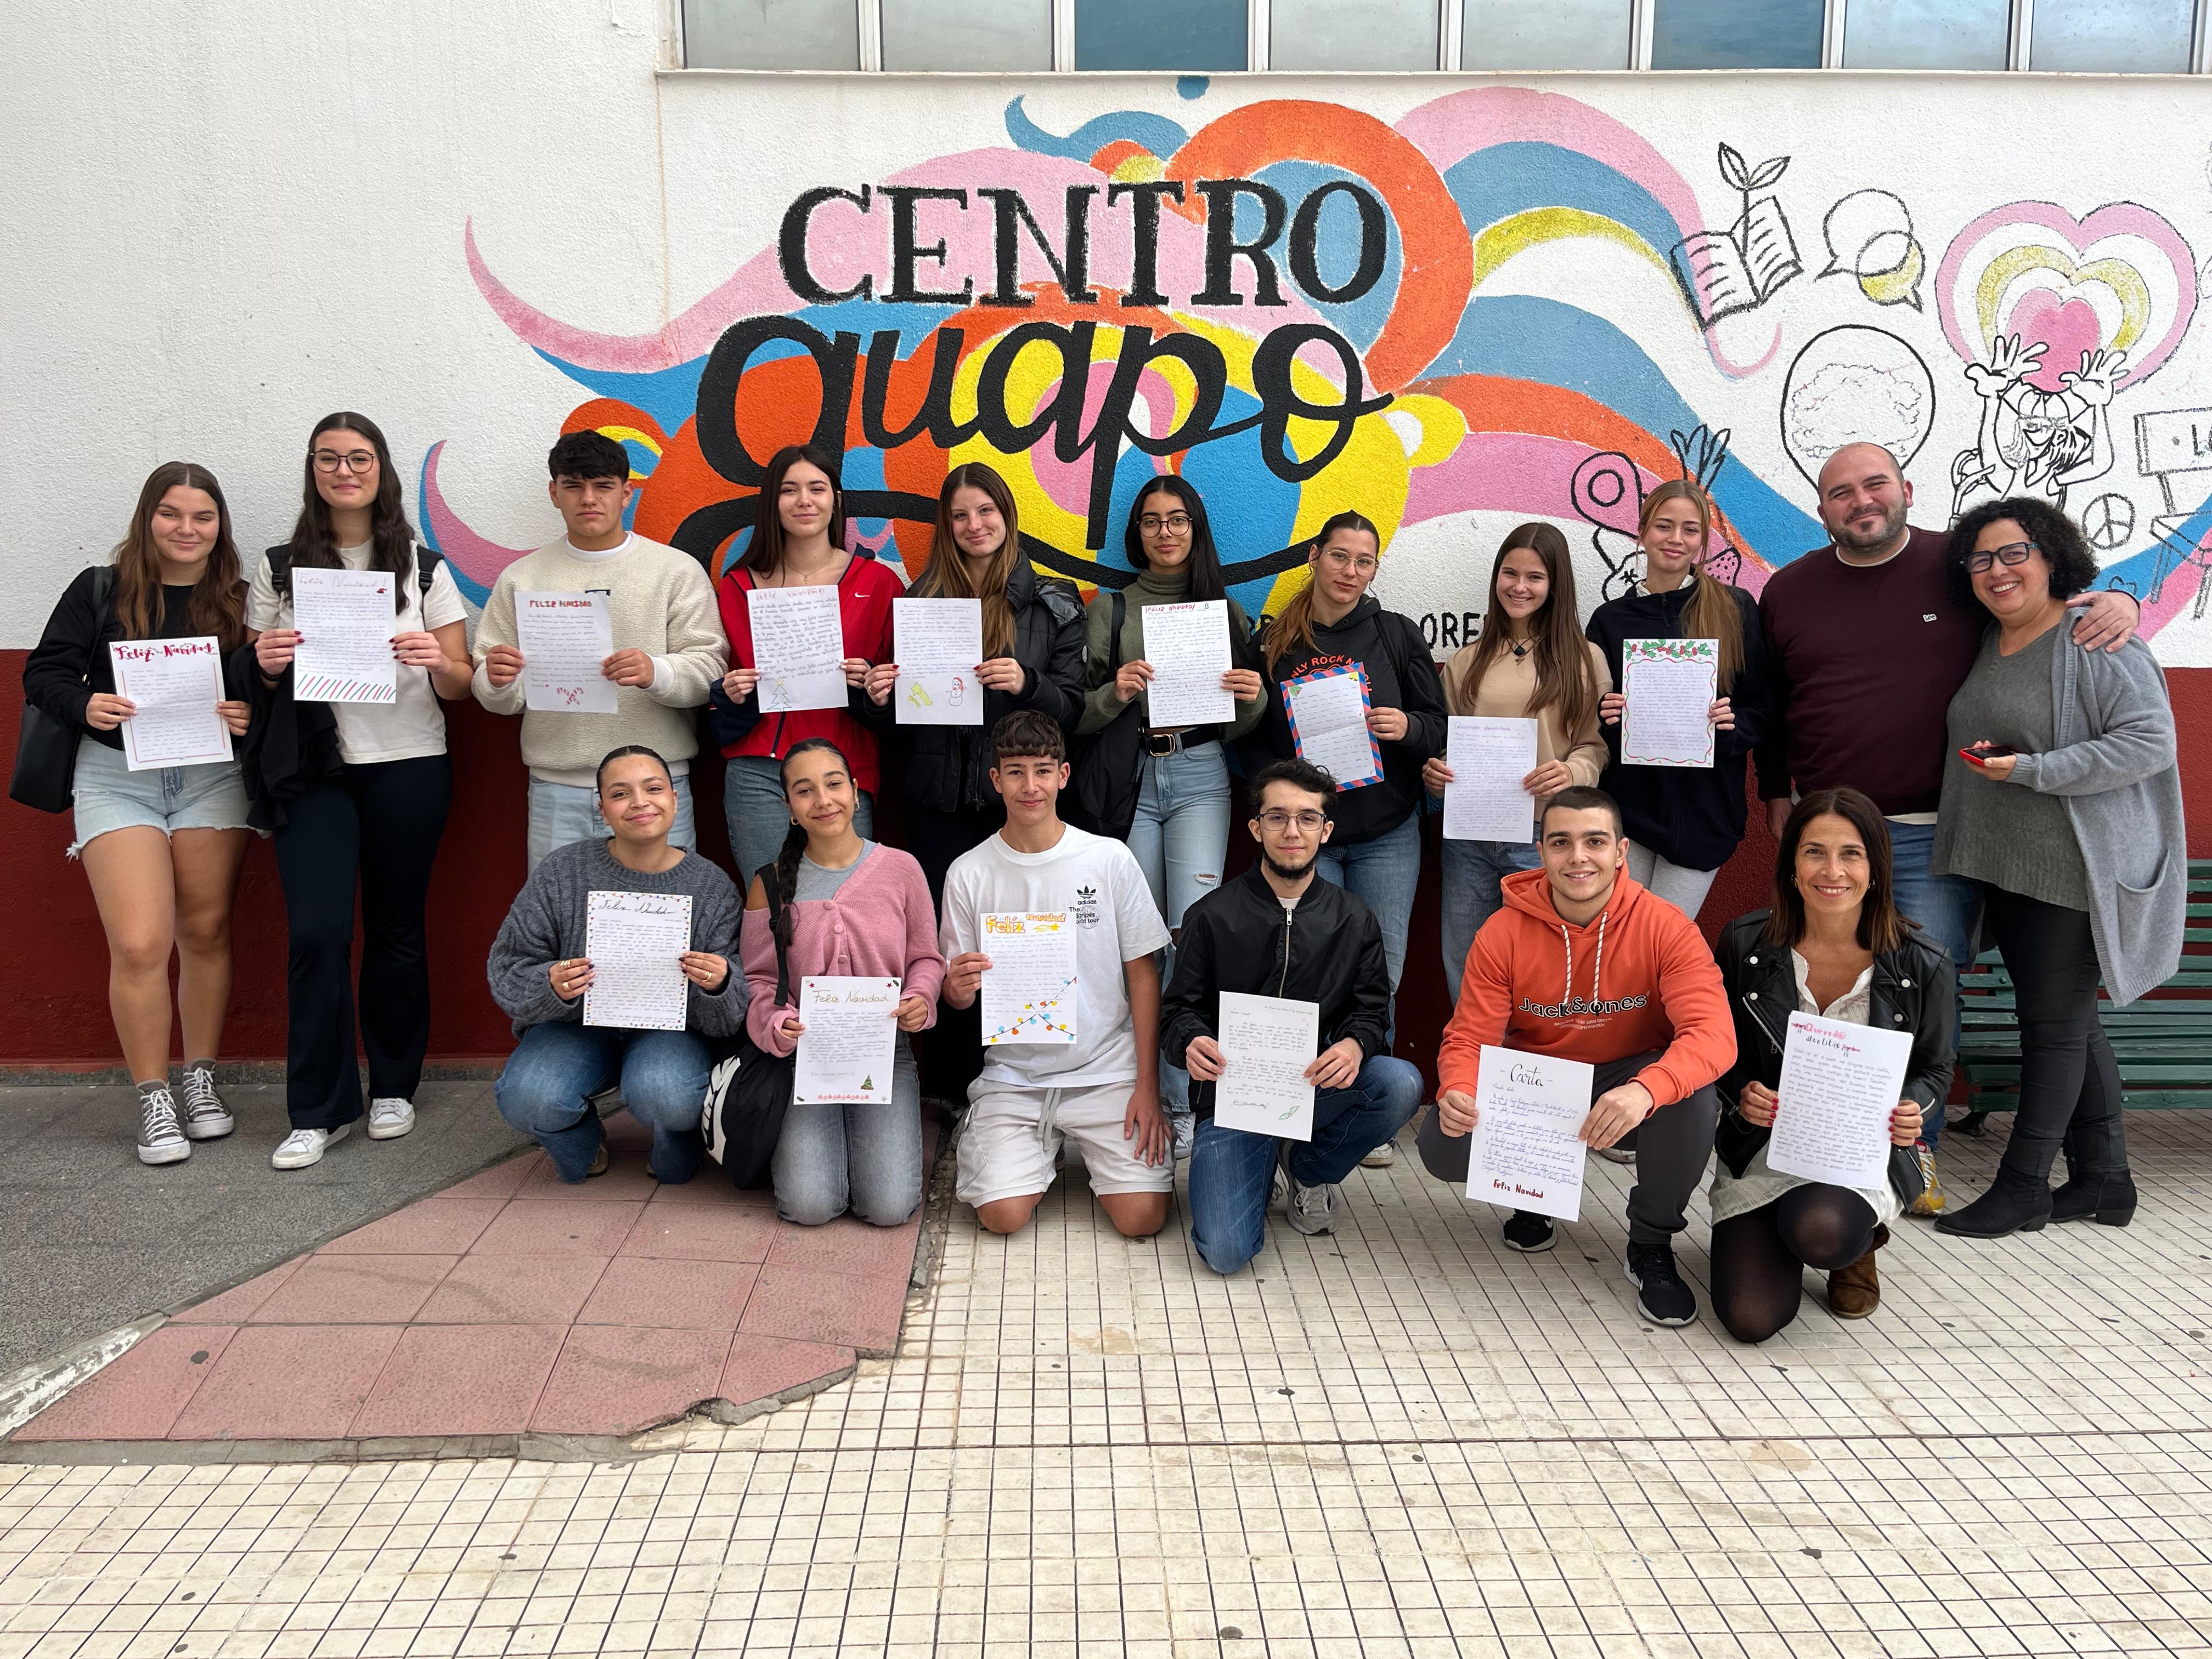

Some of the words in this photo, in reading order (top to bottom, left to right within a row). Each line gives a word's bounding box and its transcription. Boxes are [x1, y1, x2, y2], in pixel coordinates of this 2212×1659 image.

[778, 179, 1387, 308] CENTRO
[680, 314, 1395, 571] guapo
[114, 645, 155, 663] Feliz
[163, 642, 213, 658] Navidad
[1291, 662, 1308, 679] NLY
[1311, 654, 1345, 667] ROCK
[813, 990, 839, 1003] Feliz
[845, 990, 889, 1003] Navidad
[1510, 1063, 1543, 1086] Carta
[1493, 1179, 1511, 1191] Feliz
[1515, 1184, 1544, 1198] Navidad
